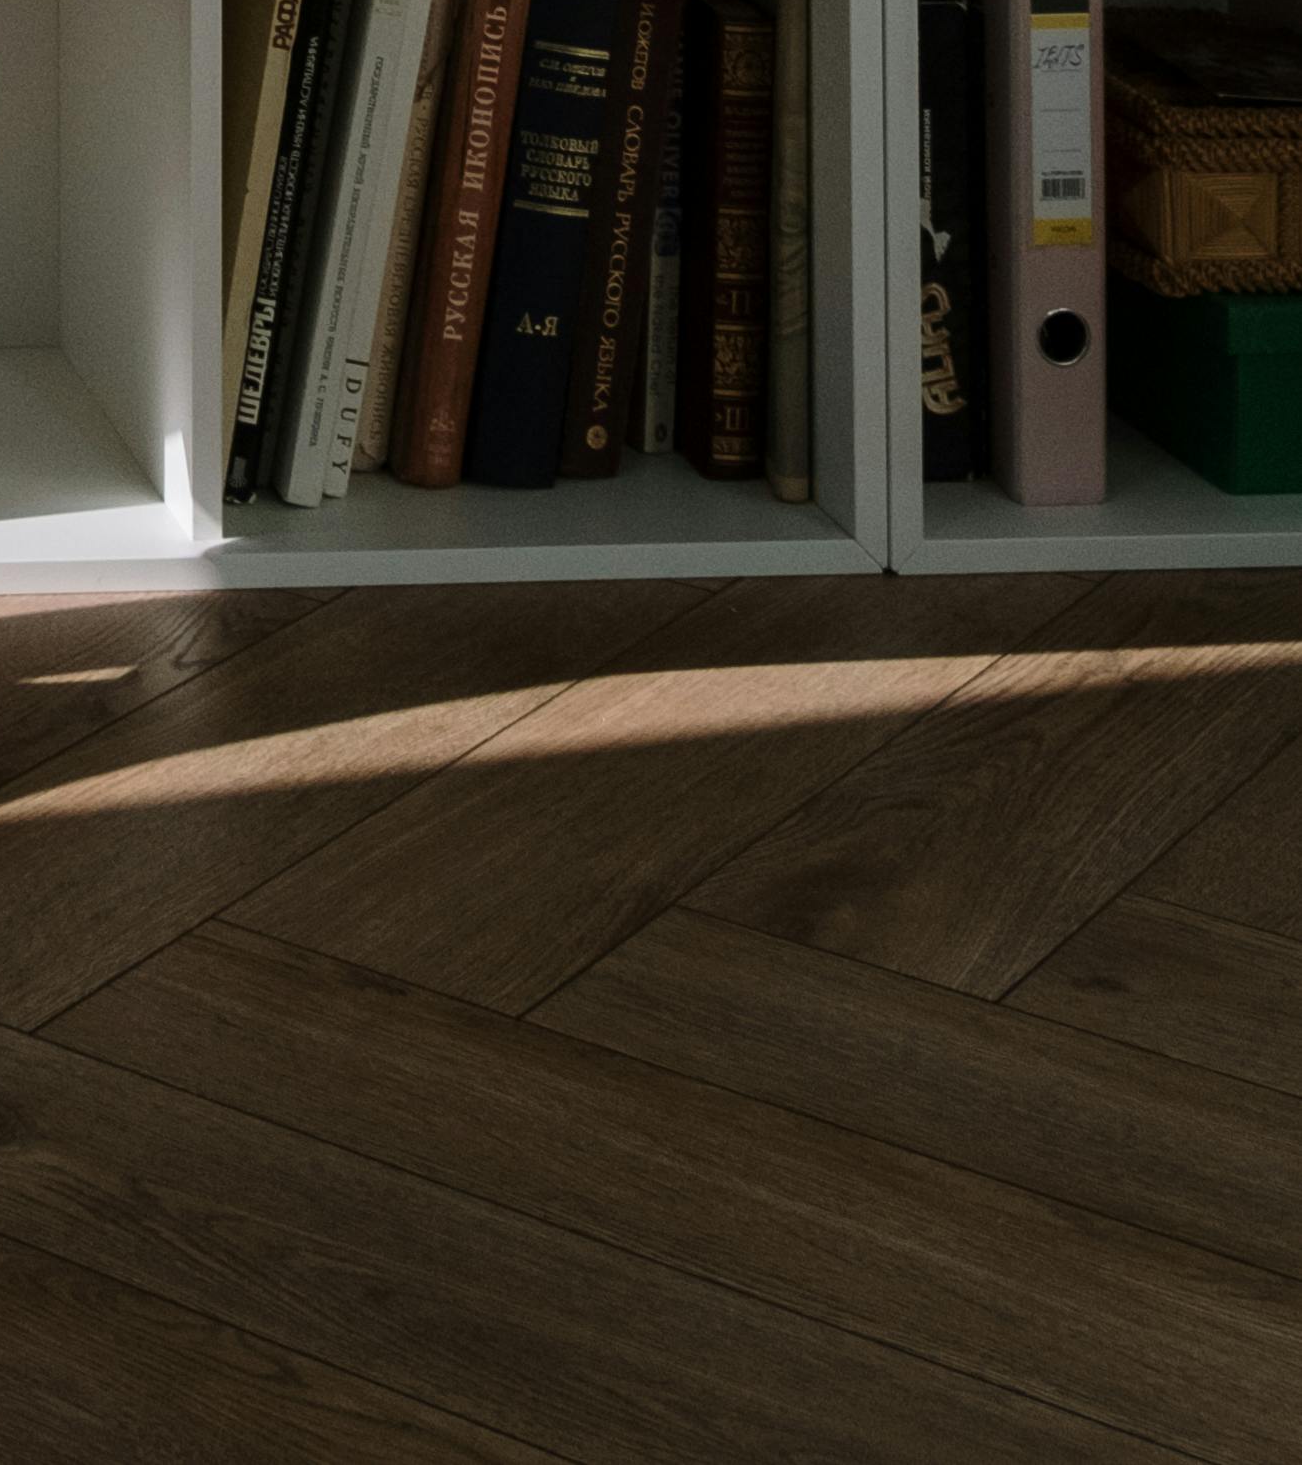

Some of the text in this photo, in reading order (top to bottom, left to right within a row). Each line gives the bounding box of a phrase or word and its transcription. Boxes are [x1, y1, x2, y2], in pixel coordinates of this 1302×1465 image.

[443, 6, 508, 341] РУССКАЯ ИКОНОПИСЬ
[520, 130, 599, 155] ТОЛКОВЫЙ
[520, 163, 593, 187] РУССКОГО
[526, 147, 590, 170] СЛОВАРЬ
[616, 105, 645, 203] СЛОВАРЬ
[528, 182, 579, 202] ЯЗЫКА
[384, 196, 413, 337] СРЕДНЕВЕКОВАЯ
[602, 211, 632, 329] РУССКОГО
[237, 297, 277, 426] ШЕДЕВРЫ
[369, 344, 391, 441] ЖИВОПИСЬ
[592, 335, 618, 413] ЯЗЫКА
[332, 378, 362, 475] DUFY
